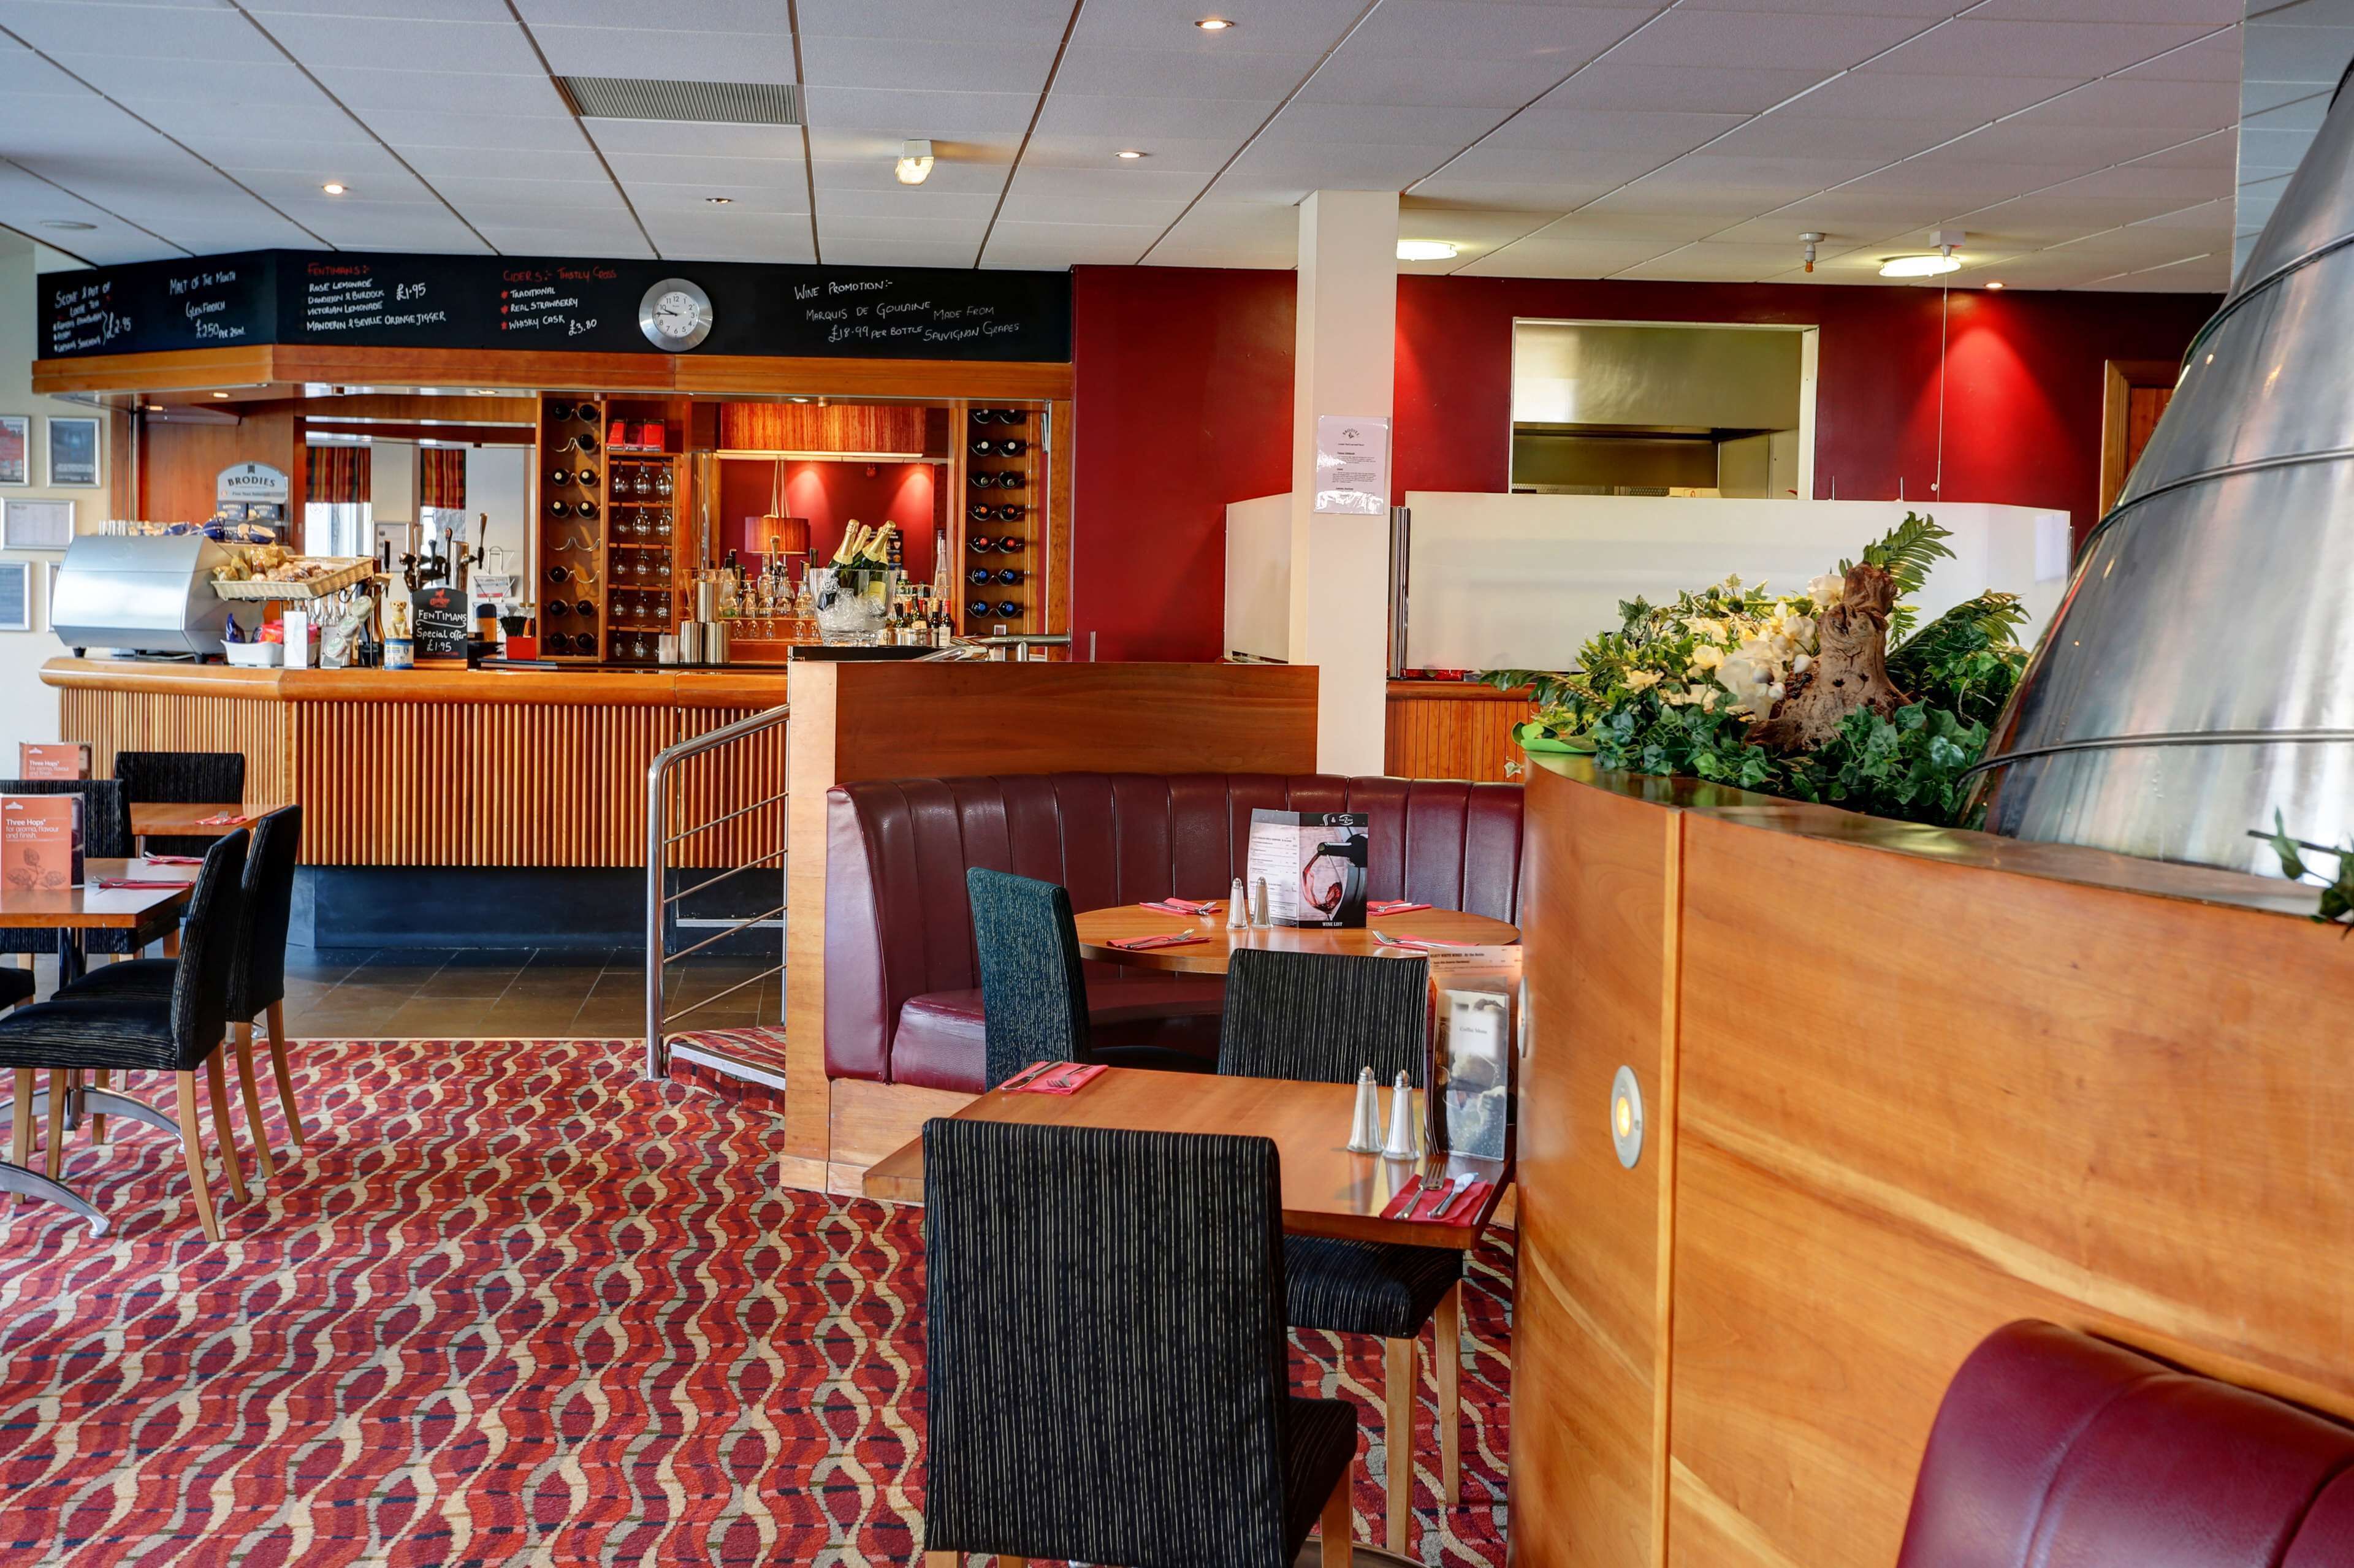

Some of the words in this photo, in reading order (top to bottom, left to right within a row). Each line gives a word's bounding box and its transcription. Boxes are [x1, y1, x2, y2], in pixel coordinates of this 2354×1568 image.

[593, 266, 617, 279] CROSS
[169, 278, 188, 295] MALT
[191, 276, 199, 289] OF
[216, 270, 236, 283] MONTH
[309, 283, 330, 293] ROSE
[332, 278, 373, 289] LEMONADE
[346, 291, 351, 301] &
[352, 289, 385, 301] BURDOCK
[396, 282, 426, 300] £1.95
[510, 286, 555, 299] TRADITIONAL
[794, 284, 820, 300] WINE
[307, 306, 343, 316] VICTORIAN
[345, 300, 383, 314] LEMONADE
[510, 303, 529, 313] REAL
[531, 298, 579, 310] STRAWBERRY
[806, 309, 847, 321] MARQUIS
[856, 306, 869, 316] DE
[877, 302, 931, 319] GOULAINE
[934, 309, 962, 320] MADE
[967, 305, 994, 316] FROM
[348, 319, 354, 329] &
[354, 315, 383, 326] SEVILLE
[384, 315, 416, 325] ORANGE
[416, 311, 446, 326] JIGGER
[509, 318, 539, 330] WHISKY
[543, 314, 565, 325] CASK
[569, 319, 597, 336] £3.80
[828, 324, 869, 343] £18.99
[870, 330, 887, 339] PER
[890, 326, 923, 336] BOTTLE
[923, 327, 980, 341] SAUVIGNON
[982, 321, 1019, 337] GRAPES
[227, 476, 276, 487] BRODIES
[418, 609, 467, 622] FENTIMANS
[417, 628, 448, 640] Special
[427, 639, 451, 652] £1.95
